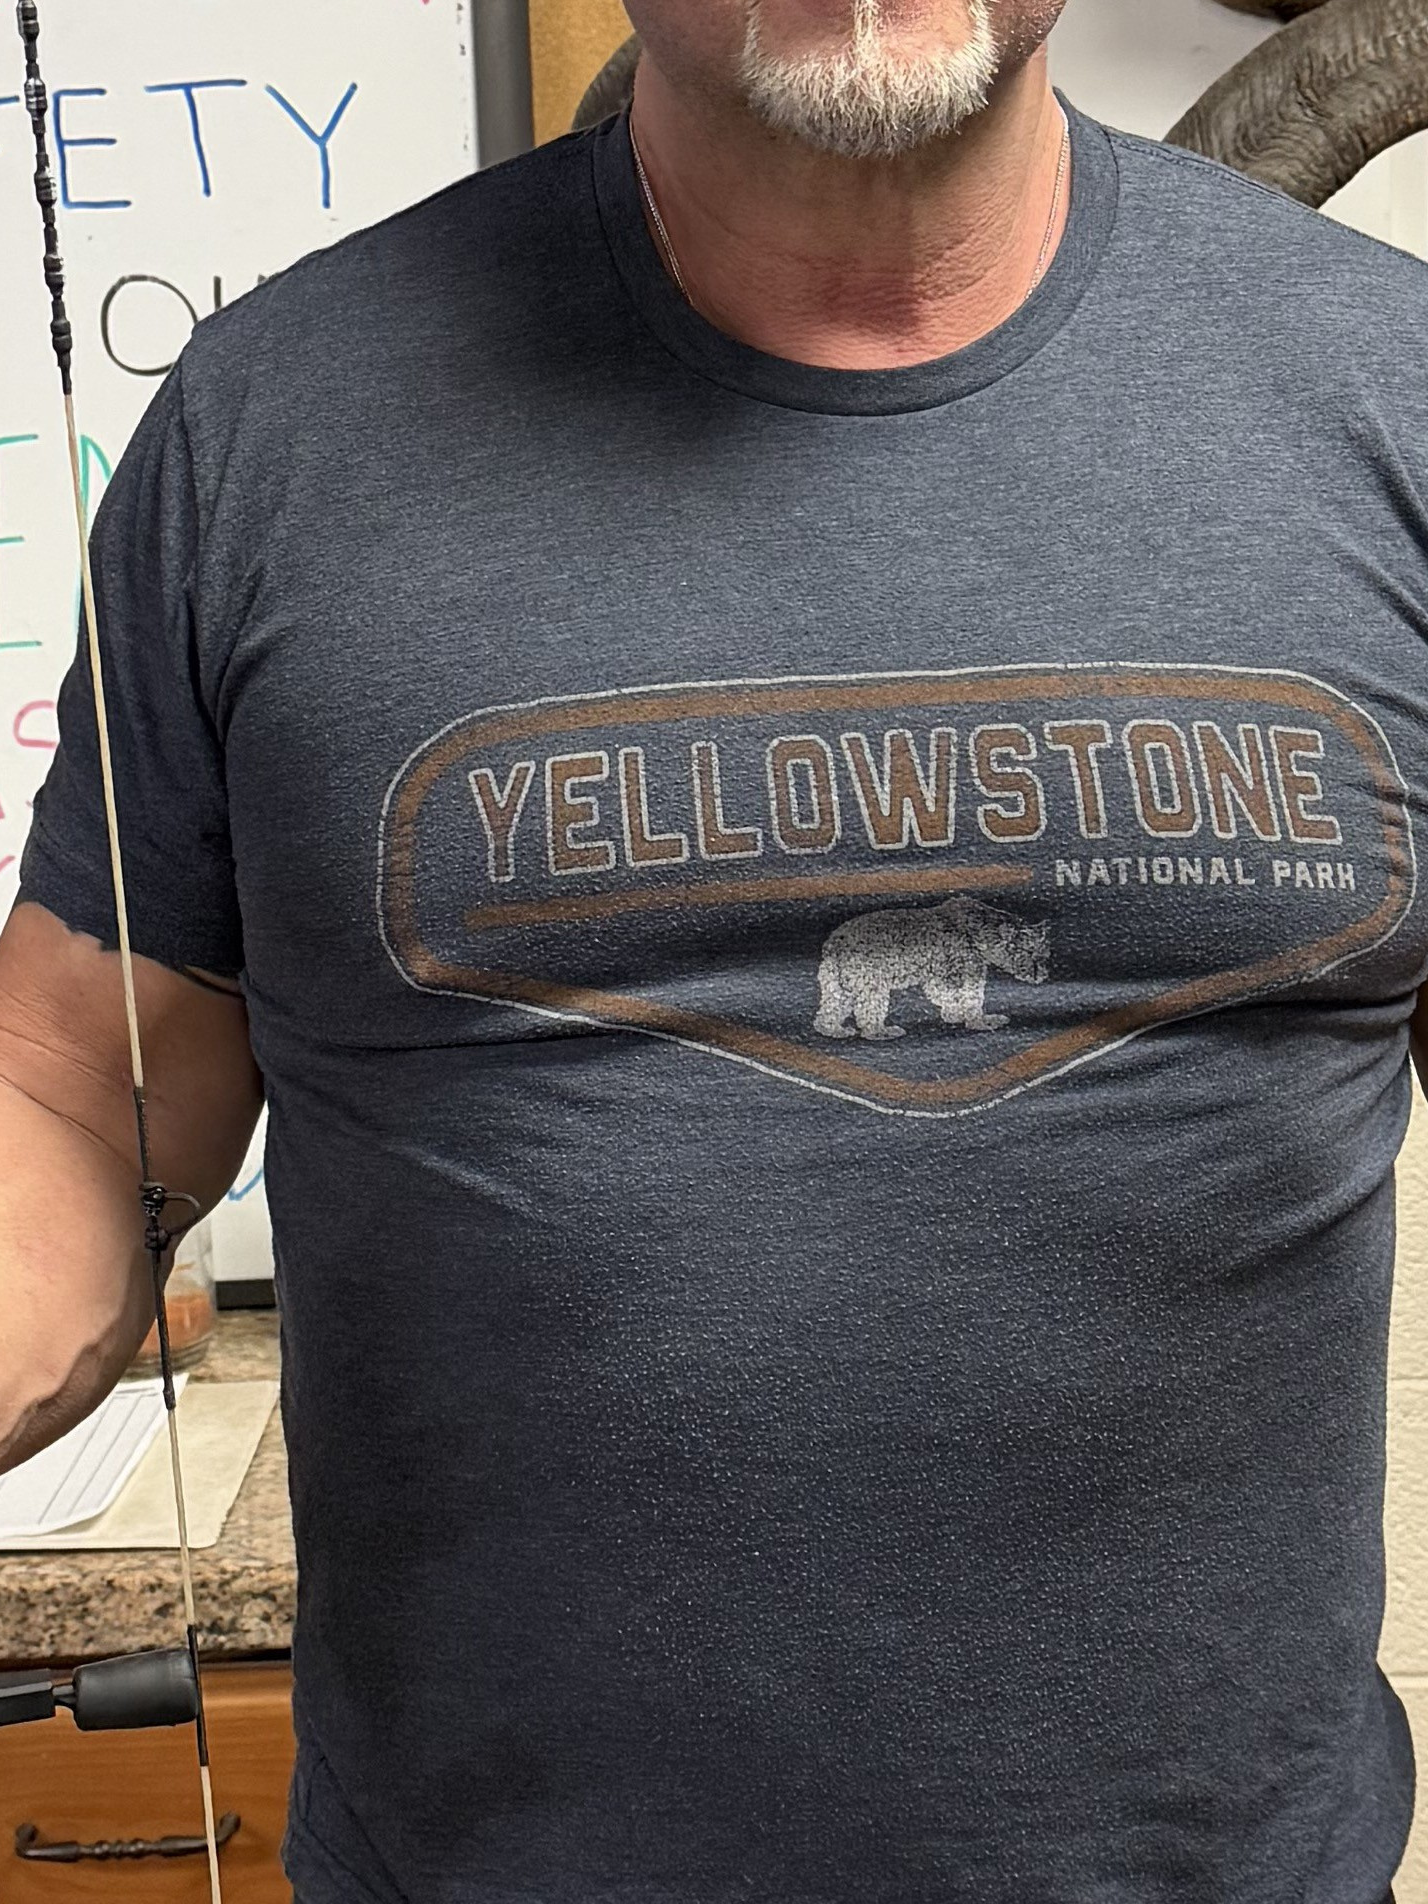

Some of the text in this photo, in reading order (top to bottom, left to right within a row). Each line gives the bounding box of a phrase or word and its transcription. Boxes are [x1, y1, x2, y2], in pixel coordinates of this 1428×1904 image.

[466, 718, 1347, 884] YELLOWSTONE
[1055, 855, 1359, 894] NATIONAL PARK
